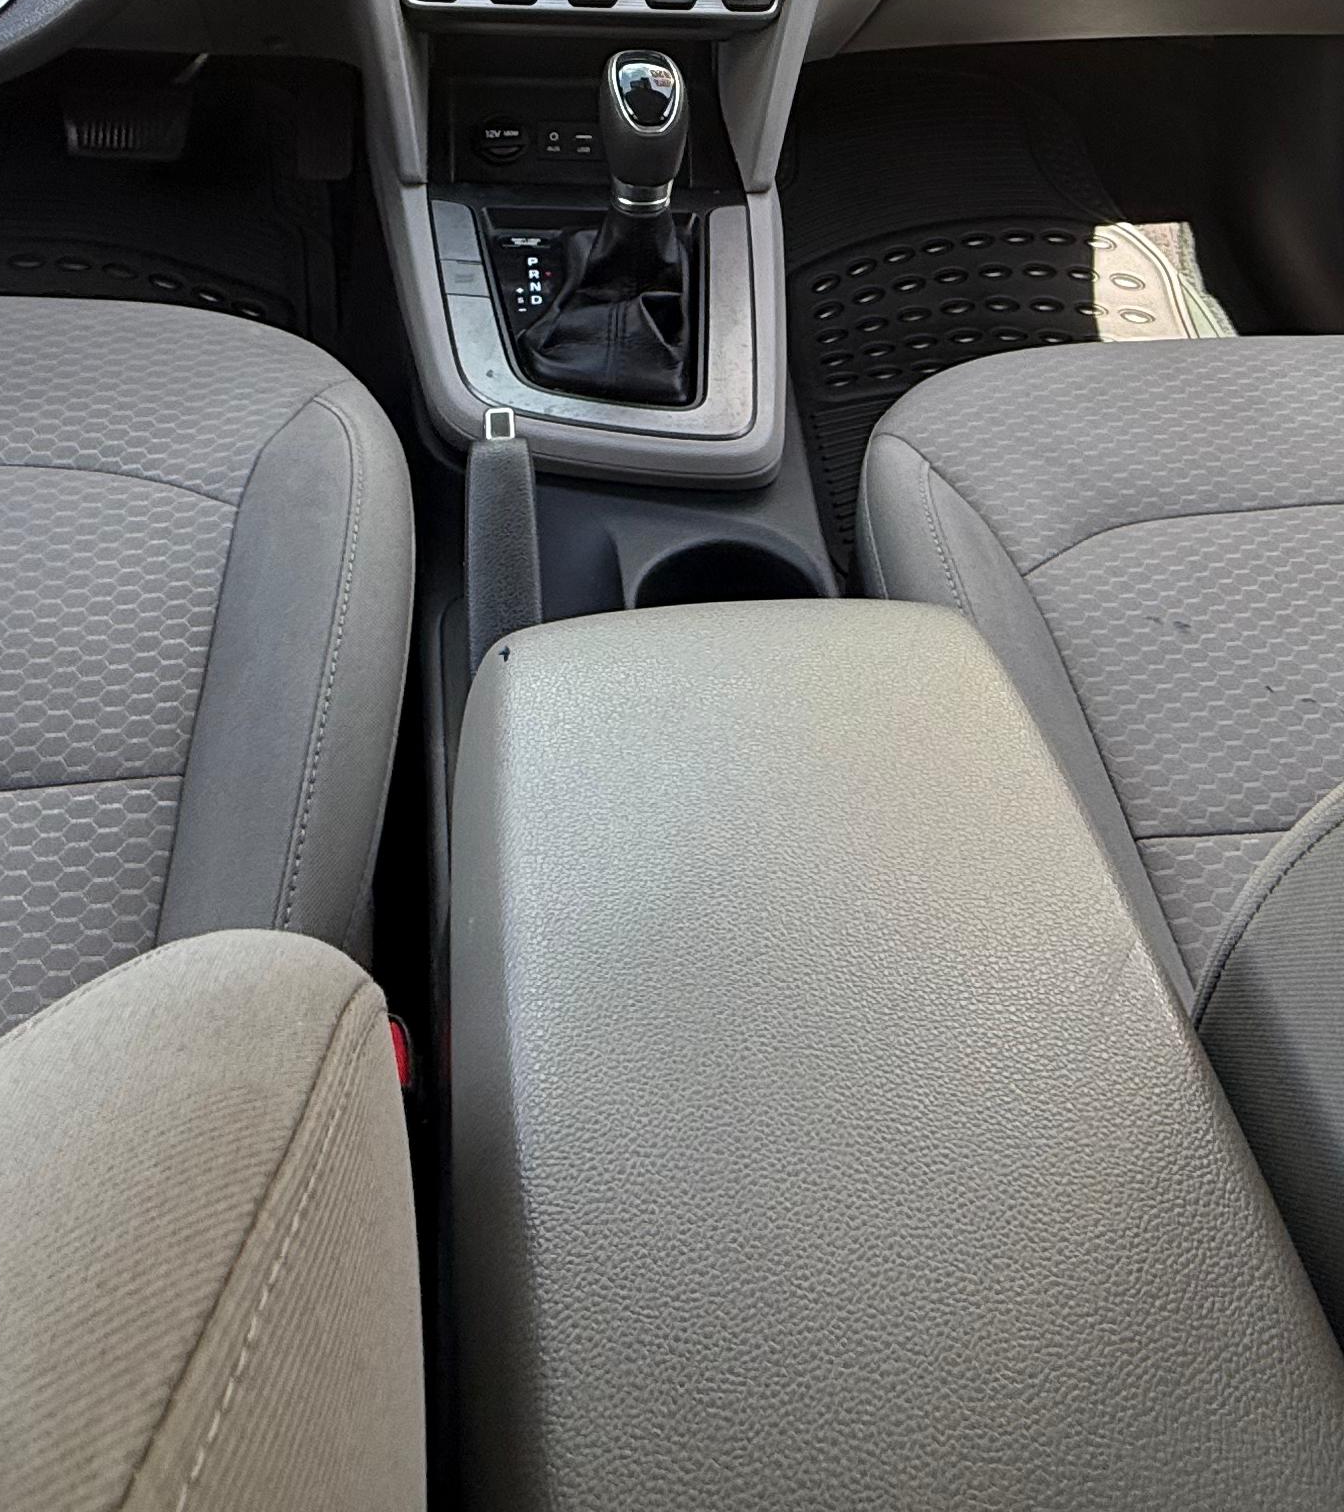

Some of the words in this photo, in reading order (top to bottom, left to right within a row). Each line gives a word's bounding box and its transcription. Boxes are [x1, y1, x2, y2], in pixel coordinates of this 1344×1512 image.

[485, 130, 501, 138] 12V
[527, 257, 538, 266] P
[528, 269, 540, 279] R
[530, 281, 542, 292] N
[531, 295, 543, 305] D
